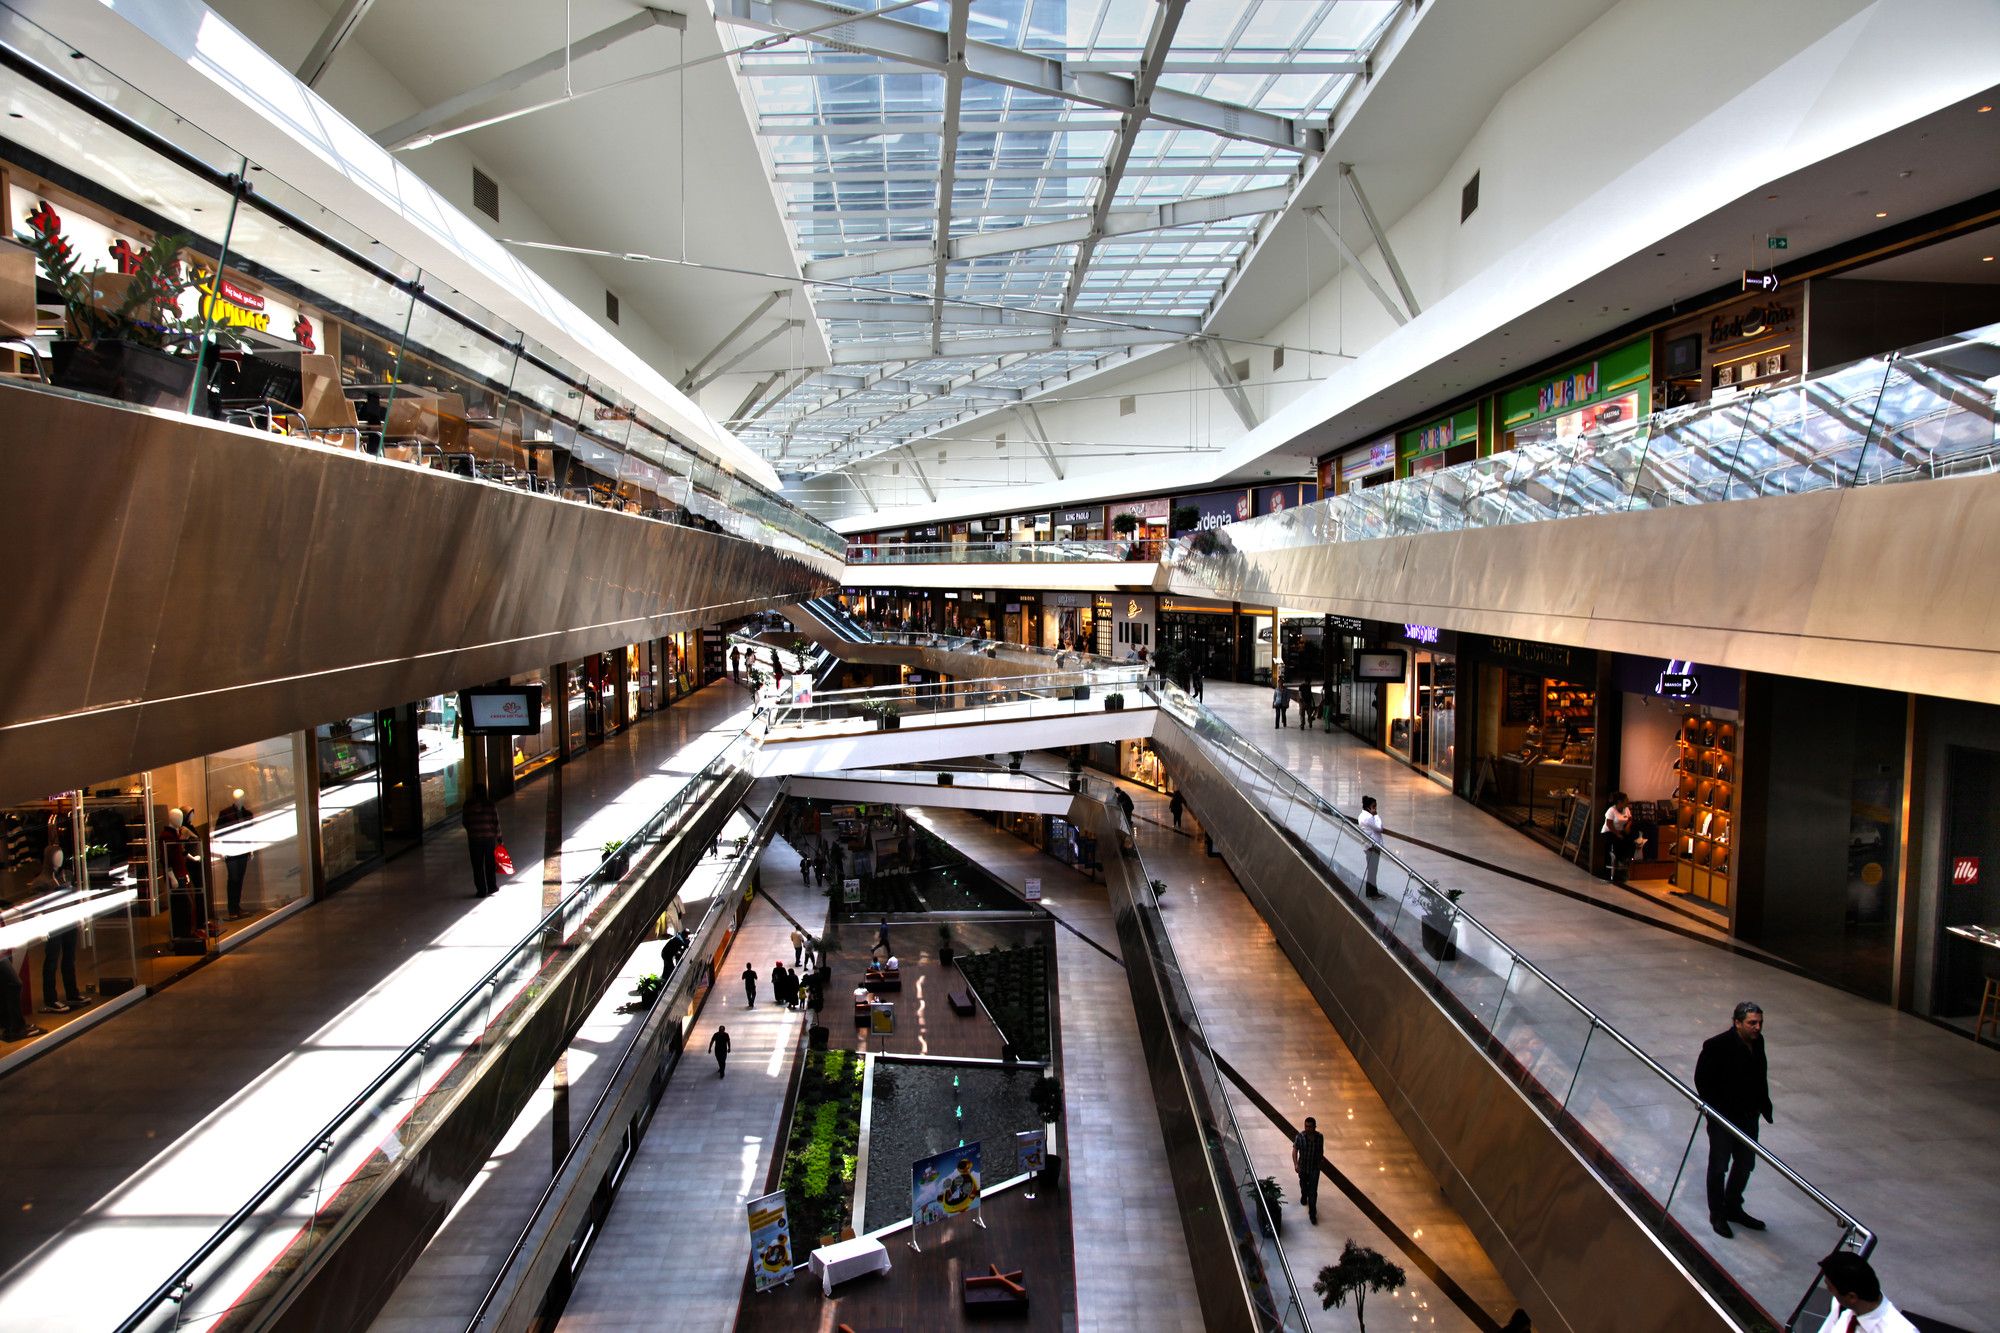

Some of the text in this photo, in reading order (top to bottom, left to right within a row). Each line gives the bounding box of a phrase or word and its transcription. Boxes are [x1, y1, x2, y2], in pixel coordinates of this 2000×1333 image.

[1763, 275, 1772, 289] P
[1188, 509, 1232, 532] rdenia
[1682, 678, 1692, 692] P
[1954, 861, 1978, 883] illy
